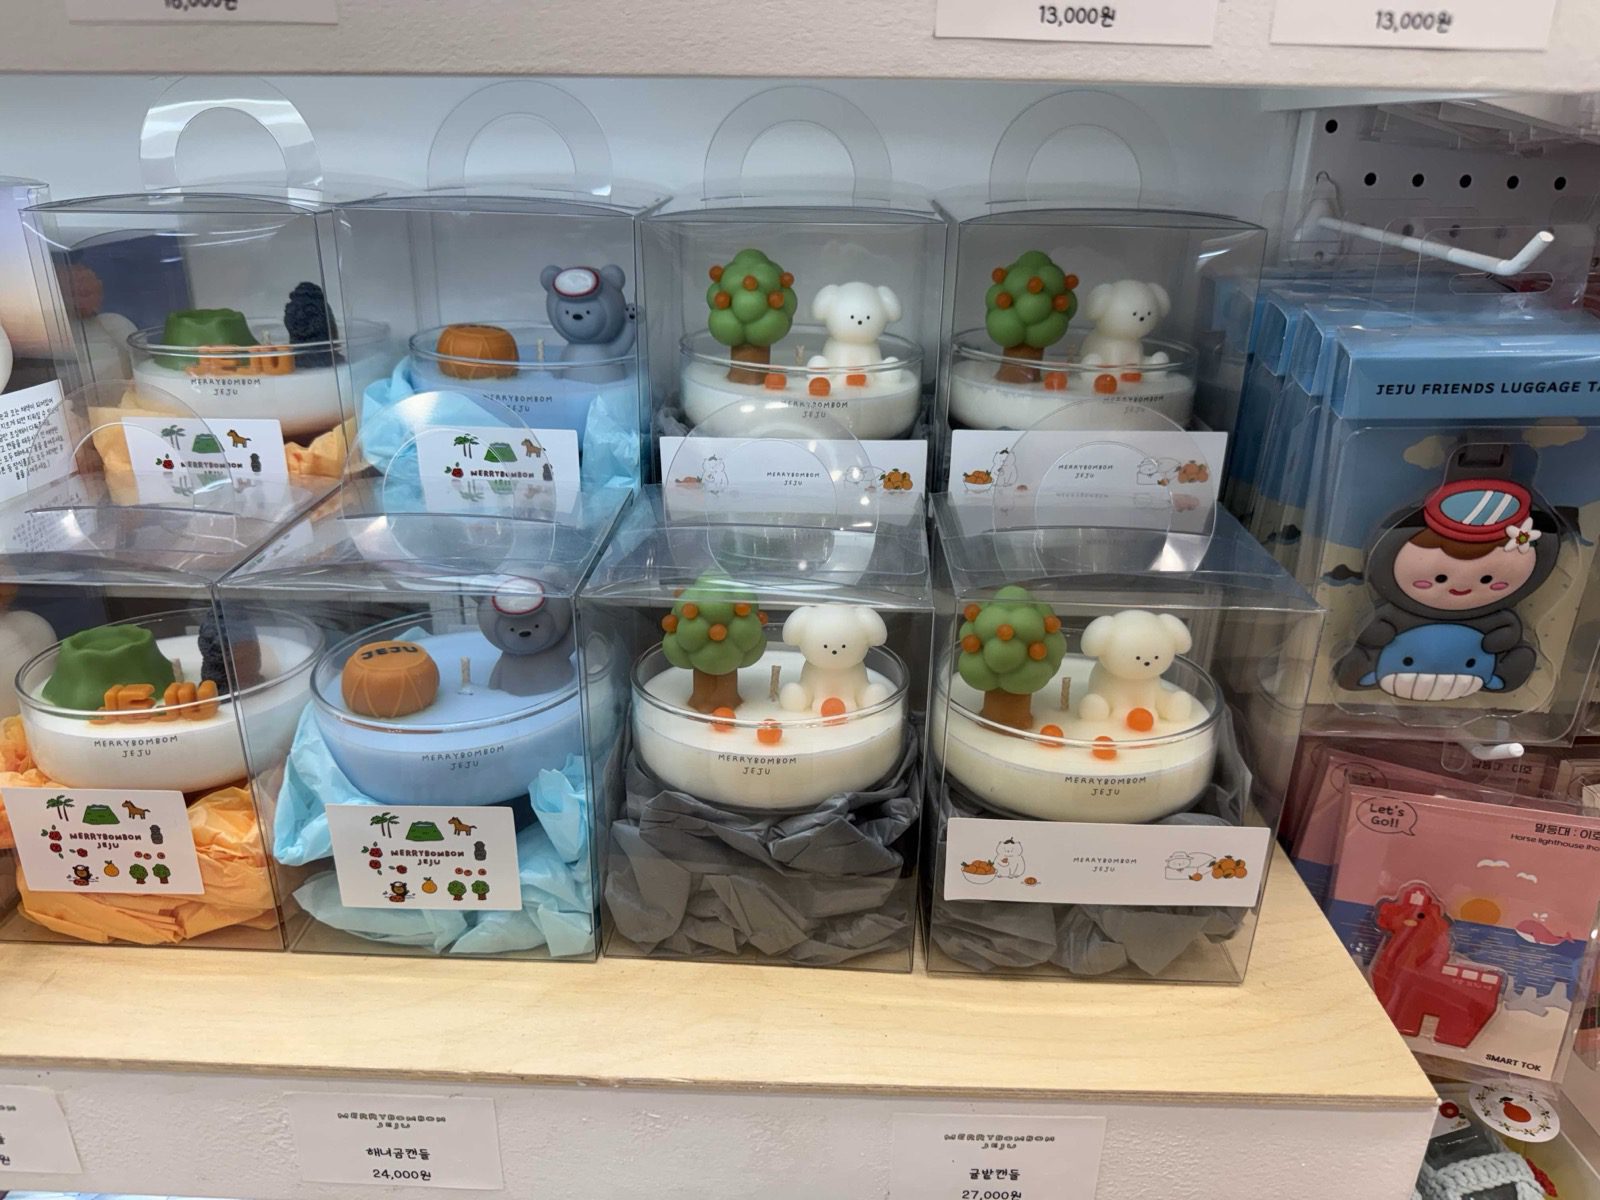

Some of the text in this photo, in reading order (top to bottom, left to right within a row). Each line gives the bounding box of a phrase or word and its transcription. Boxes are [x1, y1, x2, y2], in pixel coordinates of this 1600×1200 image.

[1039, 6, 1116, 28] 13,000원
[1376, 10, 1453, 33] 13,000원
[1376, 384, 1416, 396] JEJU
[1422, 383, 1496, 395] FRIENDS
[1501, 381, 1582, 393] LUGGAGE
[360, 646, 419, 660] JEJU
[94, 735, 179, 748] MERRYBOMBOM
[121, 749, 152, 758] JEJU
[421, 745, 505, 761] MERRYBOMBOM
[718, 754, 798, 765] MERRYBOMBOM
[449, 761, 479, 771] JEJU
[742, 767, 771, 776] JEJU
[1064, 776, 1147, 786] MERRYBOMBOM
[1090, 788, 1121, 797] JEJU
[1369, 803, 1405, 817] Let's
[1370, 815, 1400, 829] Go!!
[1534, 822, 1571, 837] 말등대
[69, 832, 142, 841] MERRYBOMBOM
[1510, 833, 1537, 843] Horse
[1538, 837, 1585, 850] lighthouse
[97, 842, 119, 850] JEJU
[390, 849, 465, 858] MERRYBOMBOM
[417, 858, 441, 867] JEJU
[1485, 1053, 1542, 1072] SMART TOK
[337, 1112, 447, 1122] MERRYBOMBOM
[376, 1122, 411, 1130] JEJU
[943, 1133, 1056, 1143] MERRYBOMBOM
[372, 1168, 432, 1182] 24,000원
[961, 1190, 1022, 1200] 27,000원
